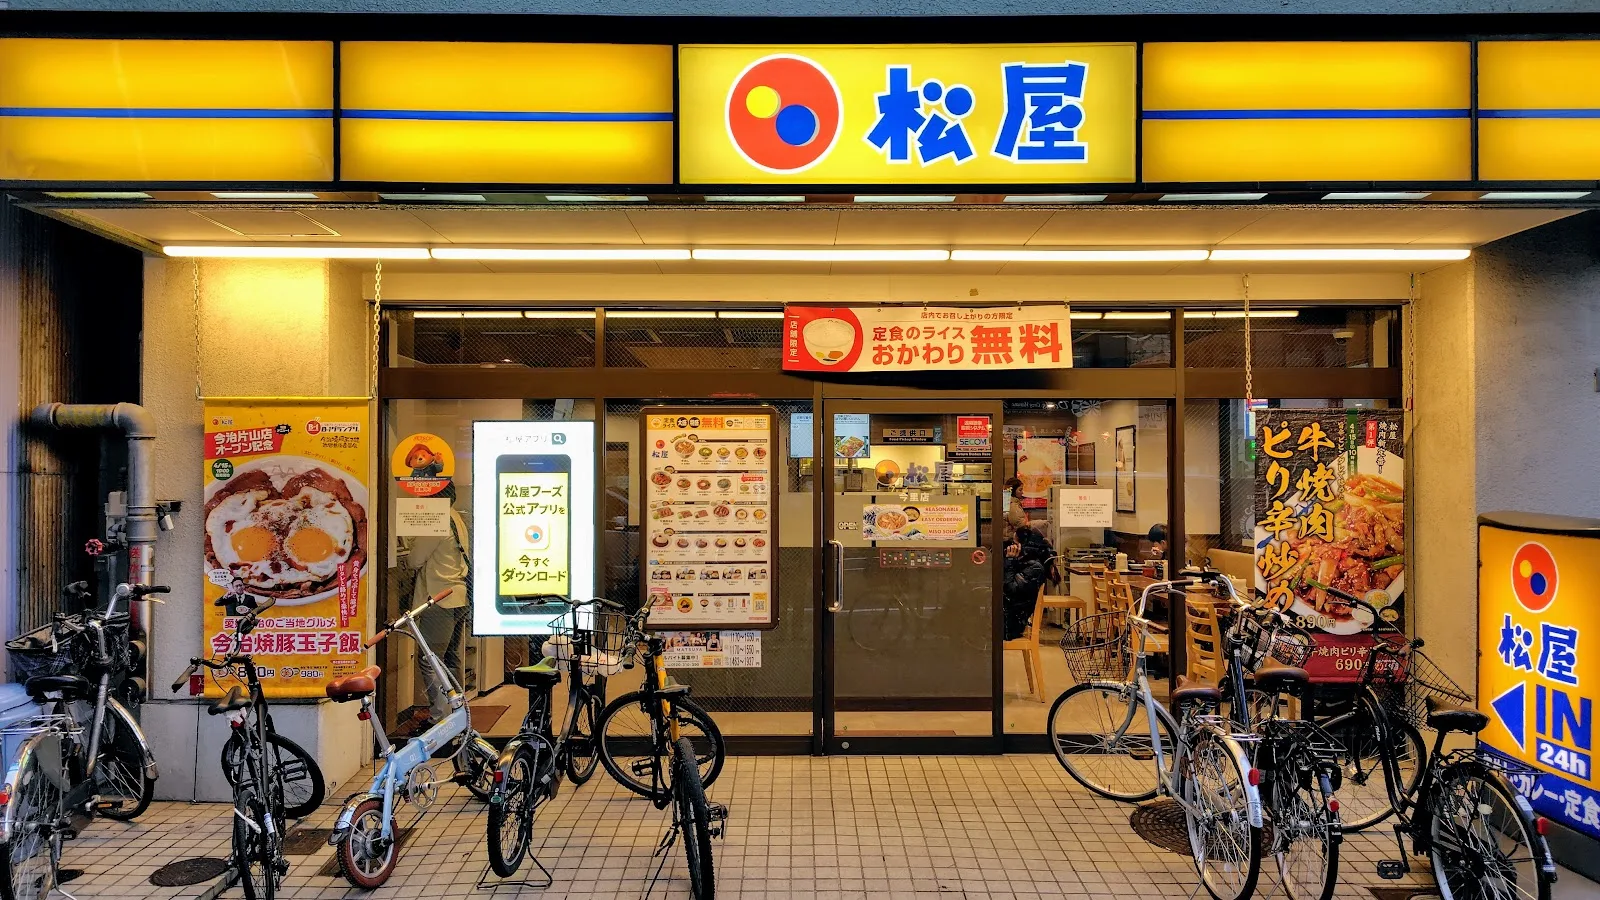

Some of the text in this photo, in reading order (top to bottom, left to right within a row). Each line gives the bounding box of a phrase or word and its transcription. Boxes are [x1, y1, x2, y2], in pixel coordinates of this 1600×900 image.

[865, 61, 1088, 166] 松屋
[920, 311, 1013, 322] 店内でお召し上がりの方限定
[872, 325, 966, 342] 定食のライス
[970, 322, 1063, 366] 無料
[871, 343, 965, 366] おかわり
[213, 428, 273, 445] 今治片山店
[1388, 421, 1398, 440] 松屋
[215, 440, 275, 456] オープン記念
[959, 438, 987, 446] SECOM
[905, 461, 954, 485] 松屋
[1296, 421, 1336, 543] 牛焼肉
[504, 484, 563, 498] 松屋フーズ
[899, 492, 930, 502] 今里店
[503, 502, 566, 516] 公式アプリを
[837, 522, 858, 531] OPEN
[518, 554, 550, 568] 今すぐ
[502, 568, 567, 583] ダウンロード
[224, 618, 336, 630] 愛治のご当地グルメ
[1295, 615, 1336, 629] 890円
[1497, 614, 1579, 687] 松屋
[1536, 684, 1592, 751] IN
[1540, 742, 1587, 777] 24h
